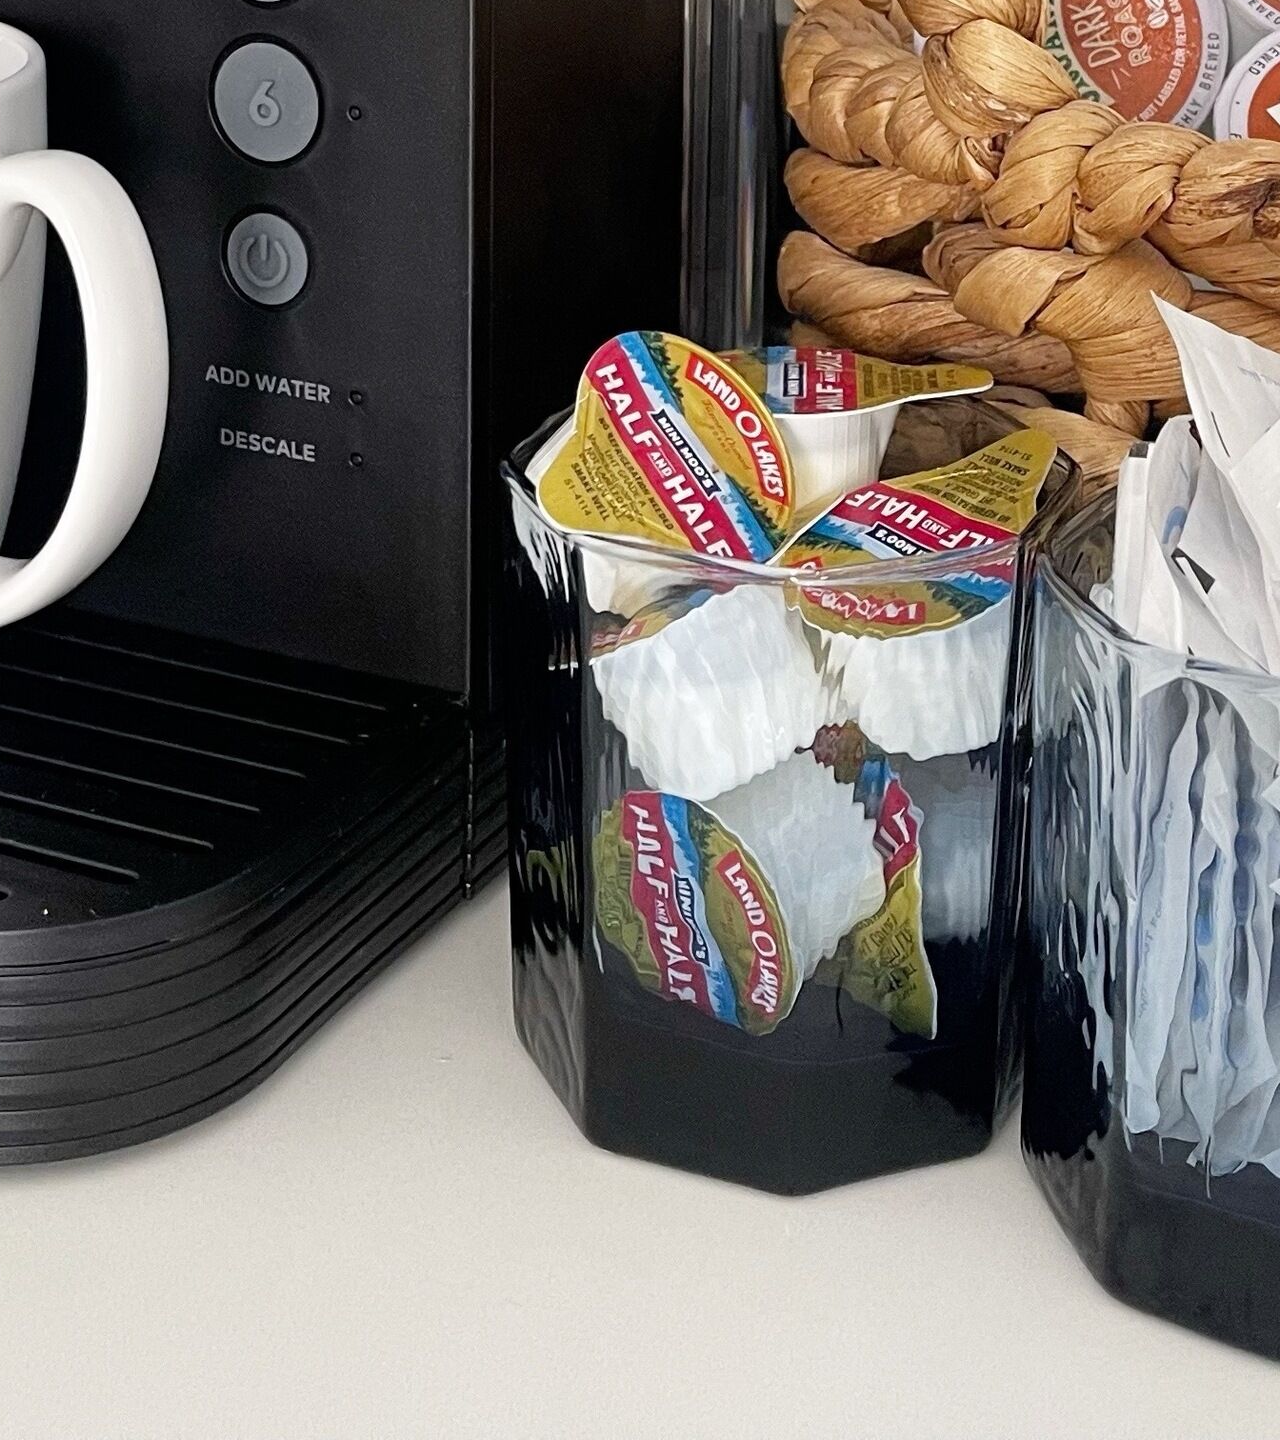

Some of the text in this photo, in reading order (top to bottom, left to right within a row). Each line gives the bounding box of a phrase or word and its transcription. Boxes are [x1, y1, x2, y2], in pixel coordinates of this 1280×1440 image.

[1200, 31, 1220, 91] BREWED
[249, 81, 282, 127] 6
[205, 365, 331, 406] ADD WATER
[220, 427, 316, 463] DESCALE
[658, 415, 715, 491] MINI MOO'S
[693, 361, 741, 411] LAND
[751, 440, 786, 498] LAKES
[595, 363, 735, 558] HALF AND HALF
[607, 431, 652, 498] REFRIGERATION
[845, 489, 919, 530] HALF
[921, 517, 950, 536] AND
[874, 528, 918, 558] MOO'S
[627, 803, 698, 1005] HALF AND HALF
[725, 861, 766, 926] LAND
